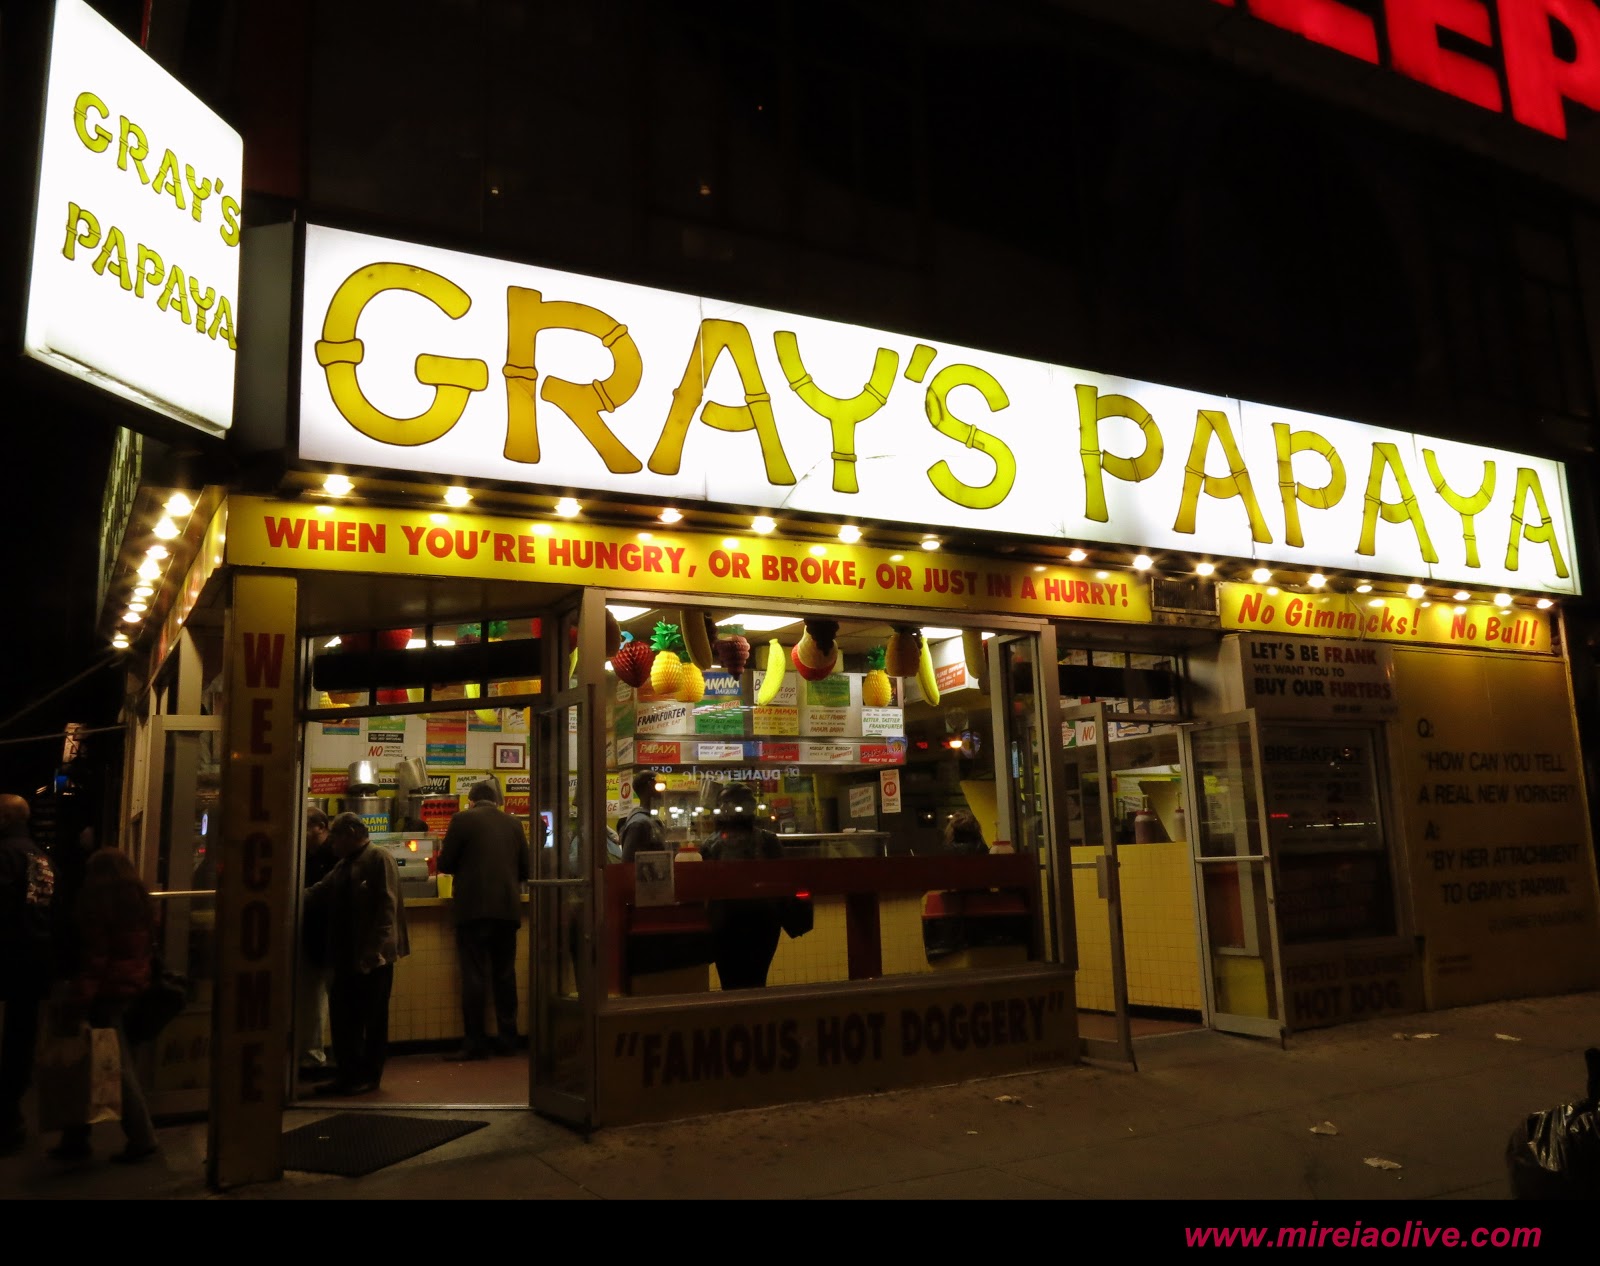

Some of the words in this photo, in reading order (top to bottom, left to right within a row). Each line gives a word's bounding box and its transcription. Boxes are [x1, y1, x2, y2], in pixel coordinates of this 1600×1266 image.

[73, 91, 241, 247] GRAY'S
[61, 201, 237, 350] PAPAYA
[314, 261, 1017, 510] GRAY'S
[1074, 383, 1570, 579] PAPAYA
[263, 515, 387, 554] WHEN
[400, 520, 535, 565] YOU'RE
[547, 537, 698, 578] HUNGRY,
[708, 550, 750, 579] OR
[761, 554, 866, 590] BROKE,
[875, 562, 913, 591] OR
[923, 566, 977, 595] JUST
[987, 569, 1013, 597] IN
[1021, 572, 1036, 599] A
[1044, 576, 1129, 608] HURRY!
[1237, 593, 1275, 625] No
[1285, 597, 1421, 637] Gimmicks!
[1450, 612, 1478, 640] No
[1485, 615, 1538, 646] Bull!
[1251, 641, 1296, 662] LET'S
[1299, 644, 1320, 662] BE
[1323, 646, 1377, 665] FRANK
[1254, 664, 1271, 675] WE
[1273, 664, 1304, 676] WANT
[1307, 665, 1330, 677] YOU
[1331, 666, 1345, 678] TO
[1254, 677, 1288, 696] BUY
[1292, 679, 1325, 697] OUR
[1329, 681, 1392, 700] FURTERS
[1081, 726, 1096, 742] NO
[368, 746, 384, 757] NO
[1263, 745, 1364, 763] BREAKFAST
[1469, 753, 1499, 772] CAN
[1502, 752, 1532, 772] YOU
[1534, 752, 1566, 772] TELL
[1418, 785, 1429, 803] A
[1433, 784, 1473, 804] REAL
[1477, 784, 1510, 803] NEW
[243, 632, 284, 1101] WELCOME
[1460, 848, 1489, 869] HER
[1493, 843, 1581, 867] ATTACHMENT
[1441, 884, 1463, 905] TO
[1466, 881, 1517, 904] GRAY'S
[1293, 986, 1343, 1021] HOT
[1350, 980, 1404, 1013] DOG
[614, 1018, 802, 1089] "FAMOUS
[816, 1011, 886, 1066] HOT
[901, 989, 1064, 1057] DOGGERY"
